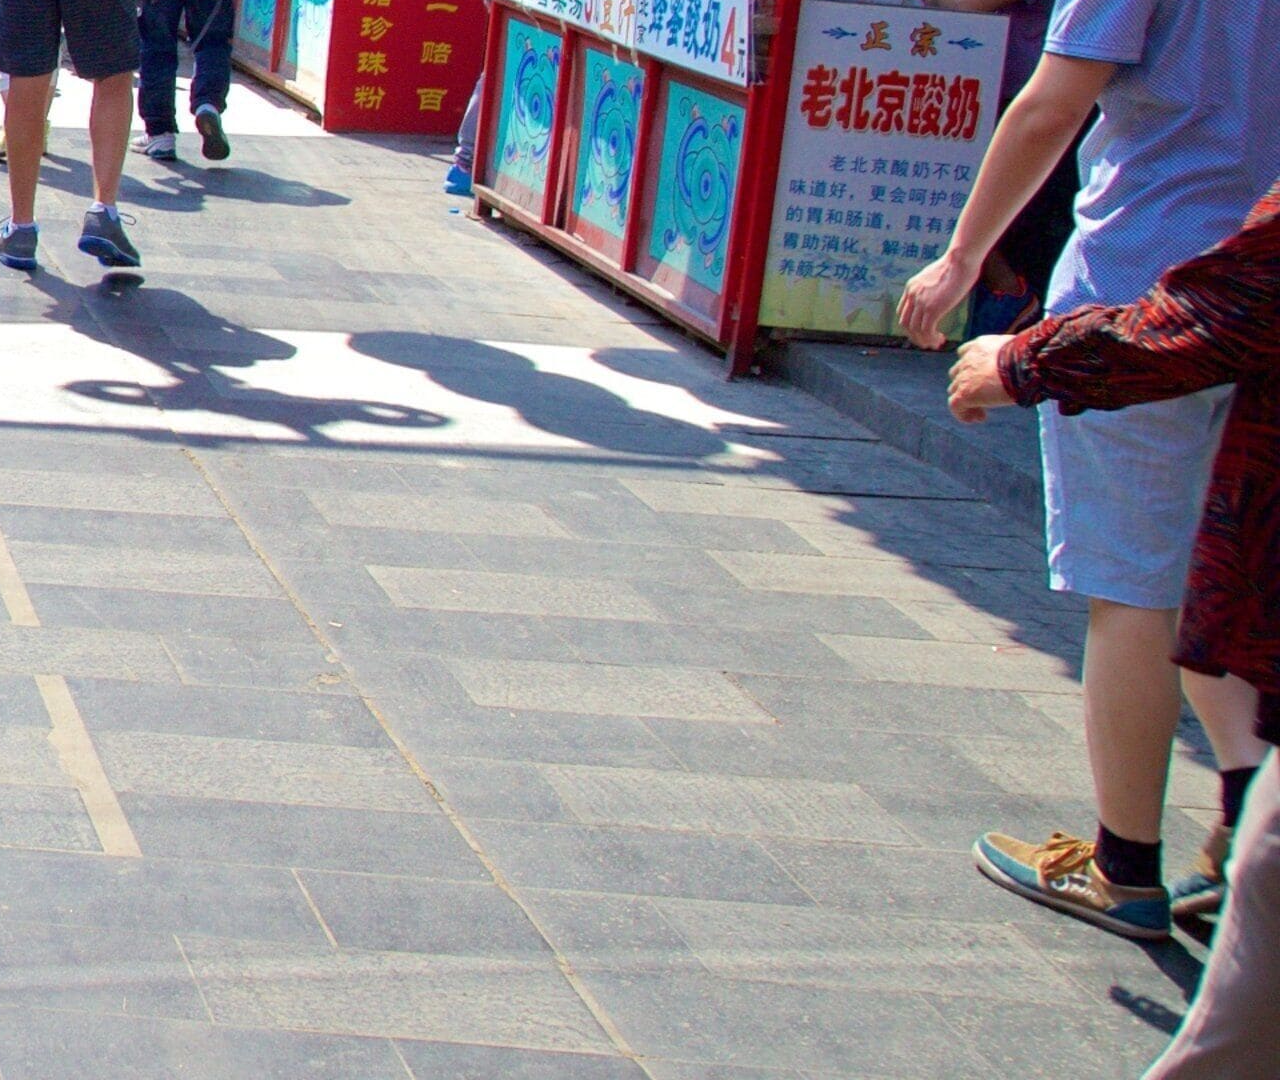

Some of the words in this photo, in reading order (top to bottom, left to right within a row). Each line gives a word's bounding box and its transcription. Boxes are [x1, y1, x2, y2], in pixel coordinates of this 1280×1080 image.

[861, 21, 941, 58] 正宗
[800, 65, 982, 142] 老北京酸奶
[829, 154, 971, 183] 老北京酸奶不仅
